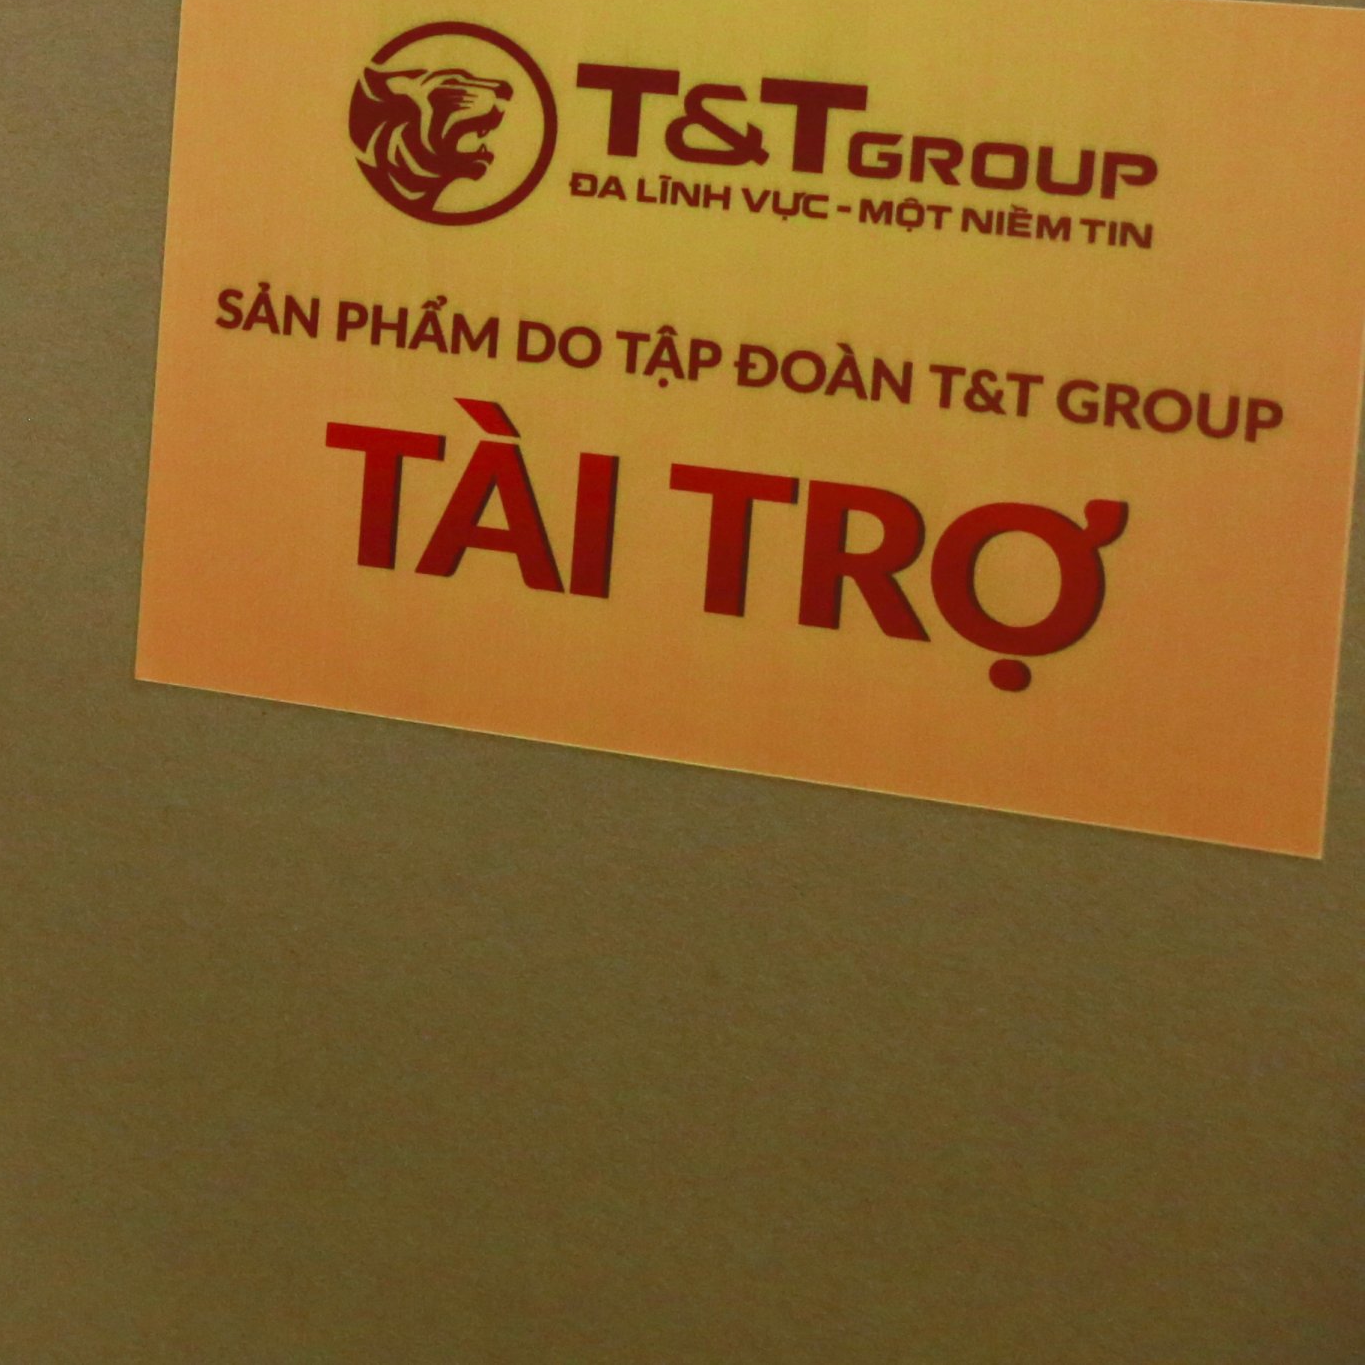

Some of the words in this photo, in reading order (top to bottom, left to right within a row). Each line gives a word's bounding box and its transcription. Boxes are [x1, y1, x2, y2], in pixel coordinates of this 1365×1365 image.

[568, 171, 628, 202] ĐA
[635, 173, 733, 212] LĨNH
[740, 186, 830, 222] VỰC
[858, 196, 954, 233] MỘT
[960, 203, 1072, 243] NIỀM
[1079, 217, 1154, 250] TIN
[214, 281, 321, 339] SẢN
[335, 294, 500, 360] PHẨM
[516, 319, 603, 370] DO
[615, 323, 723, 389] TẬP
[733, 341, 914, 405] ĐOÀN
[928, 363, 1045, 418] T&T
[1056, 378, 1284, 444] GROUP
[325, 397, 621, 600] TÀI
[668, 462, 1130, 693] TRỢ
